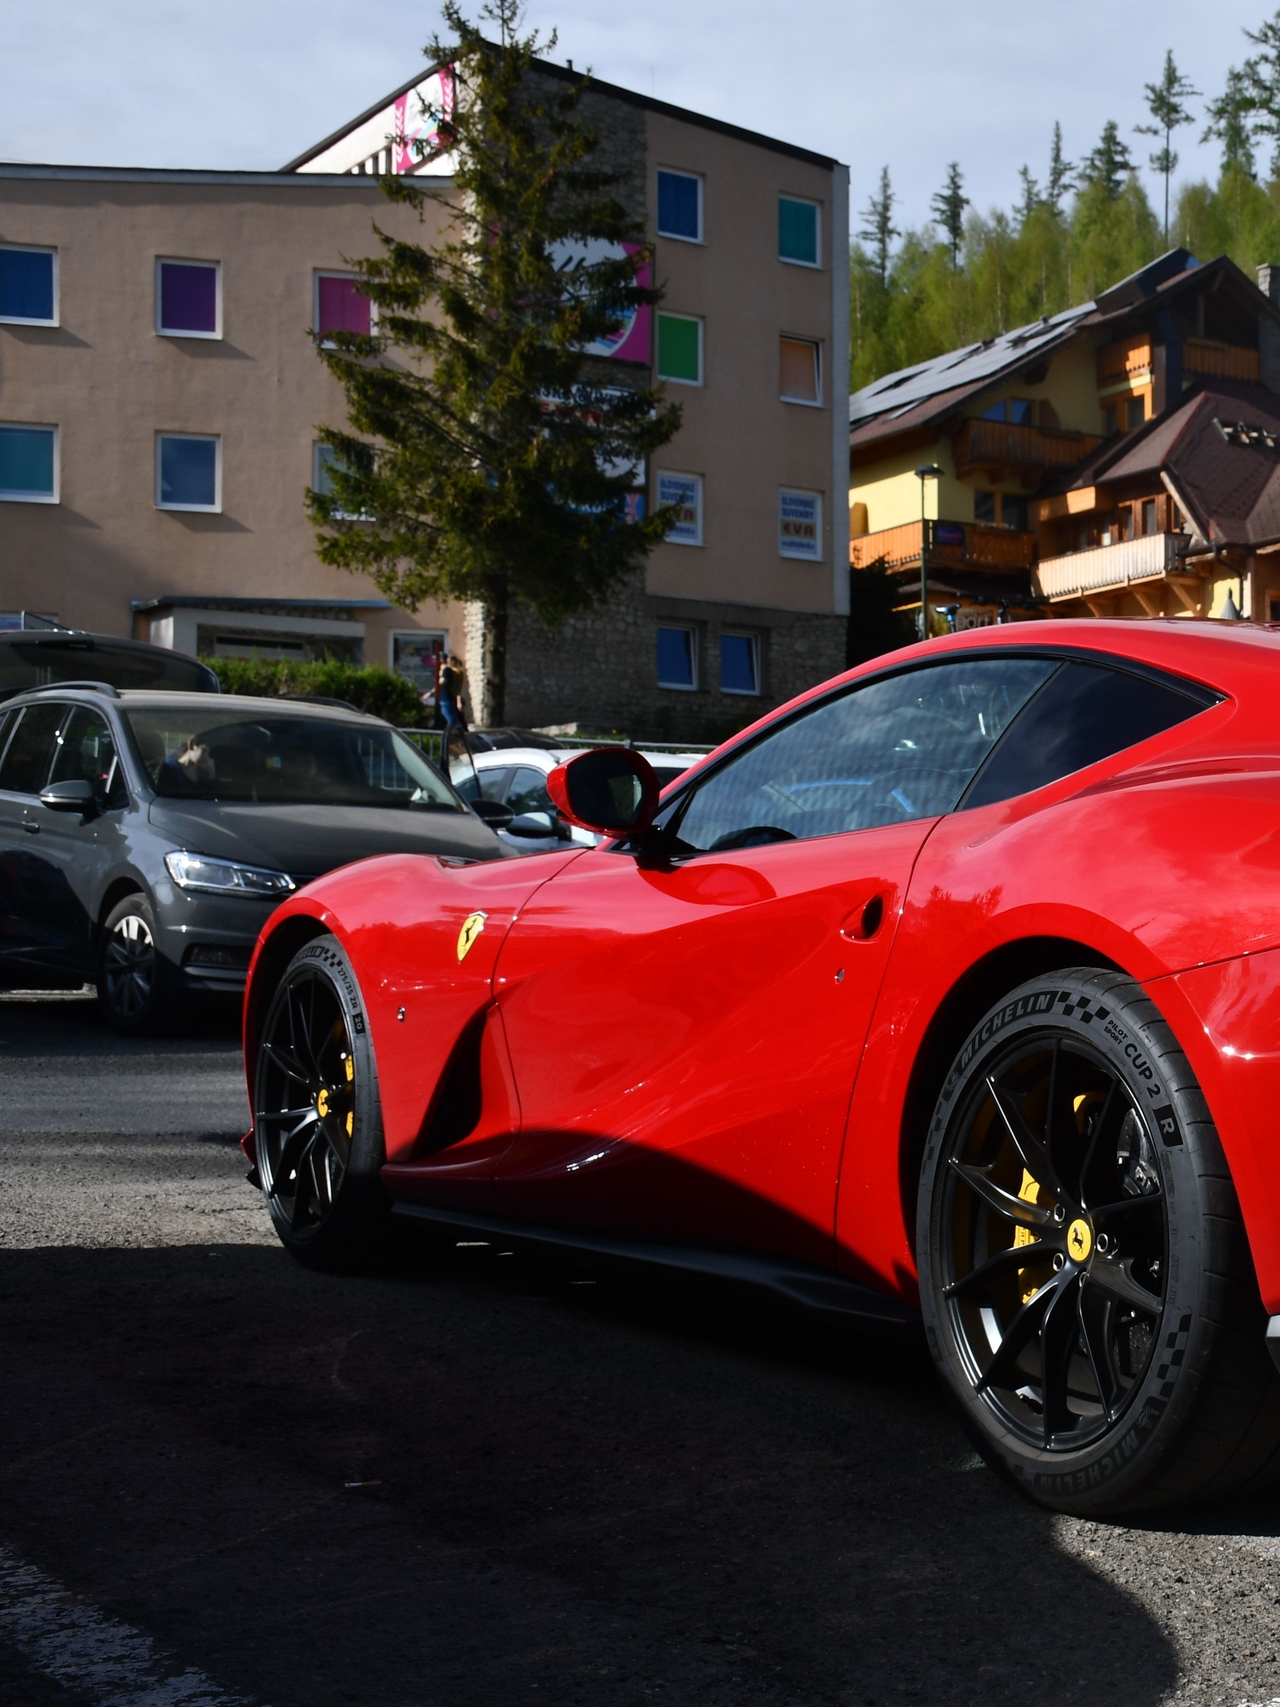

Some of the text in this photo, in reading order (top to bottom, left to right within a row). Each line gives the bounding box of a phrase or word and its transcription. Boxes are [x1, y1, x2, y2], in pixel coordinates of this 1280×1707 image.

[350, 996, 358, 1009] ZR
[354, 1017, 363, 1030] 20
[961, 993, 1051, 1069] MICHELIN
[1103, 1026, 1123, 1045] SPORT
[1108, 1019, 1129, 1040] PILOT
[1124, 1042, 1153, 1081] CUP
[1146, 1083, 1161, 1099] 2
[1040, 1429, 1140, 1491] MICHELIN
